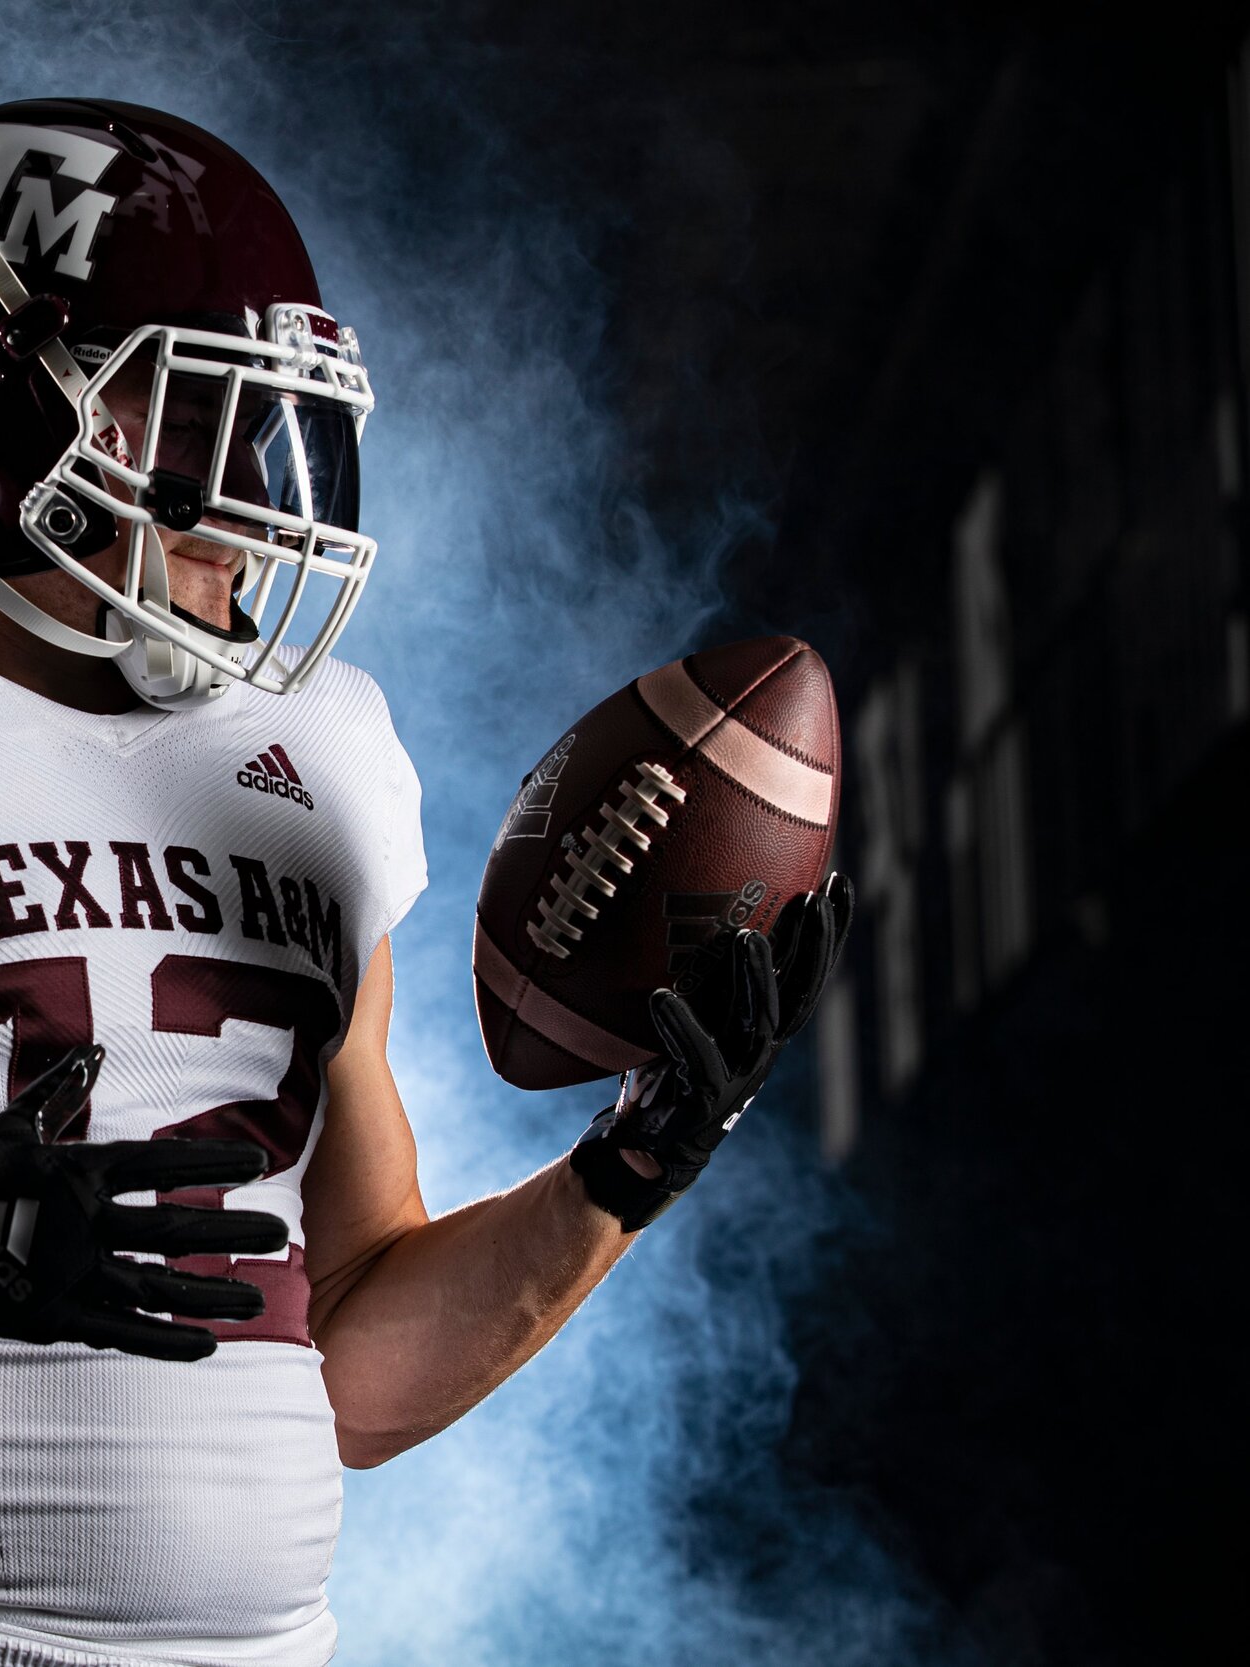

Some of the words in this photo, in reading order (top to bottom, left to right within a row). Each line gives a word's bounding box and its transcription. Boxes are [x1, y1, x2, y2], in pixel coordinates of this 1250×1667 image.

[73, 346, 115, 360] Riddel
[236, 770, 314, 811] adidas
[229, 854, 343, 990] A&M
